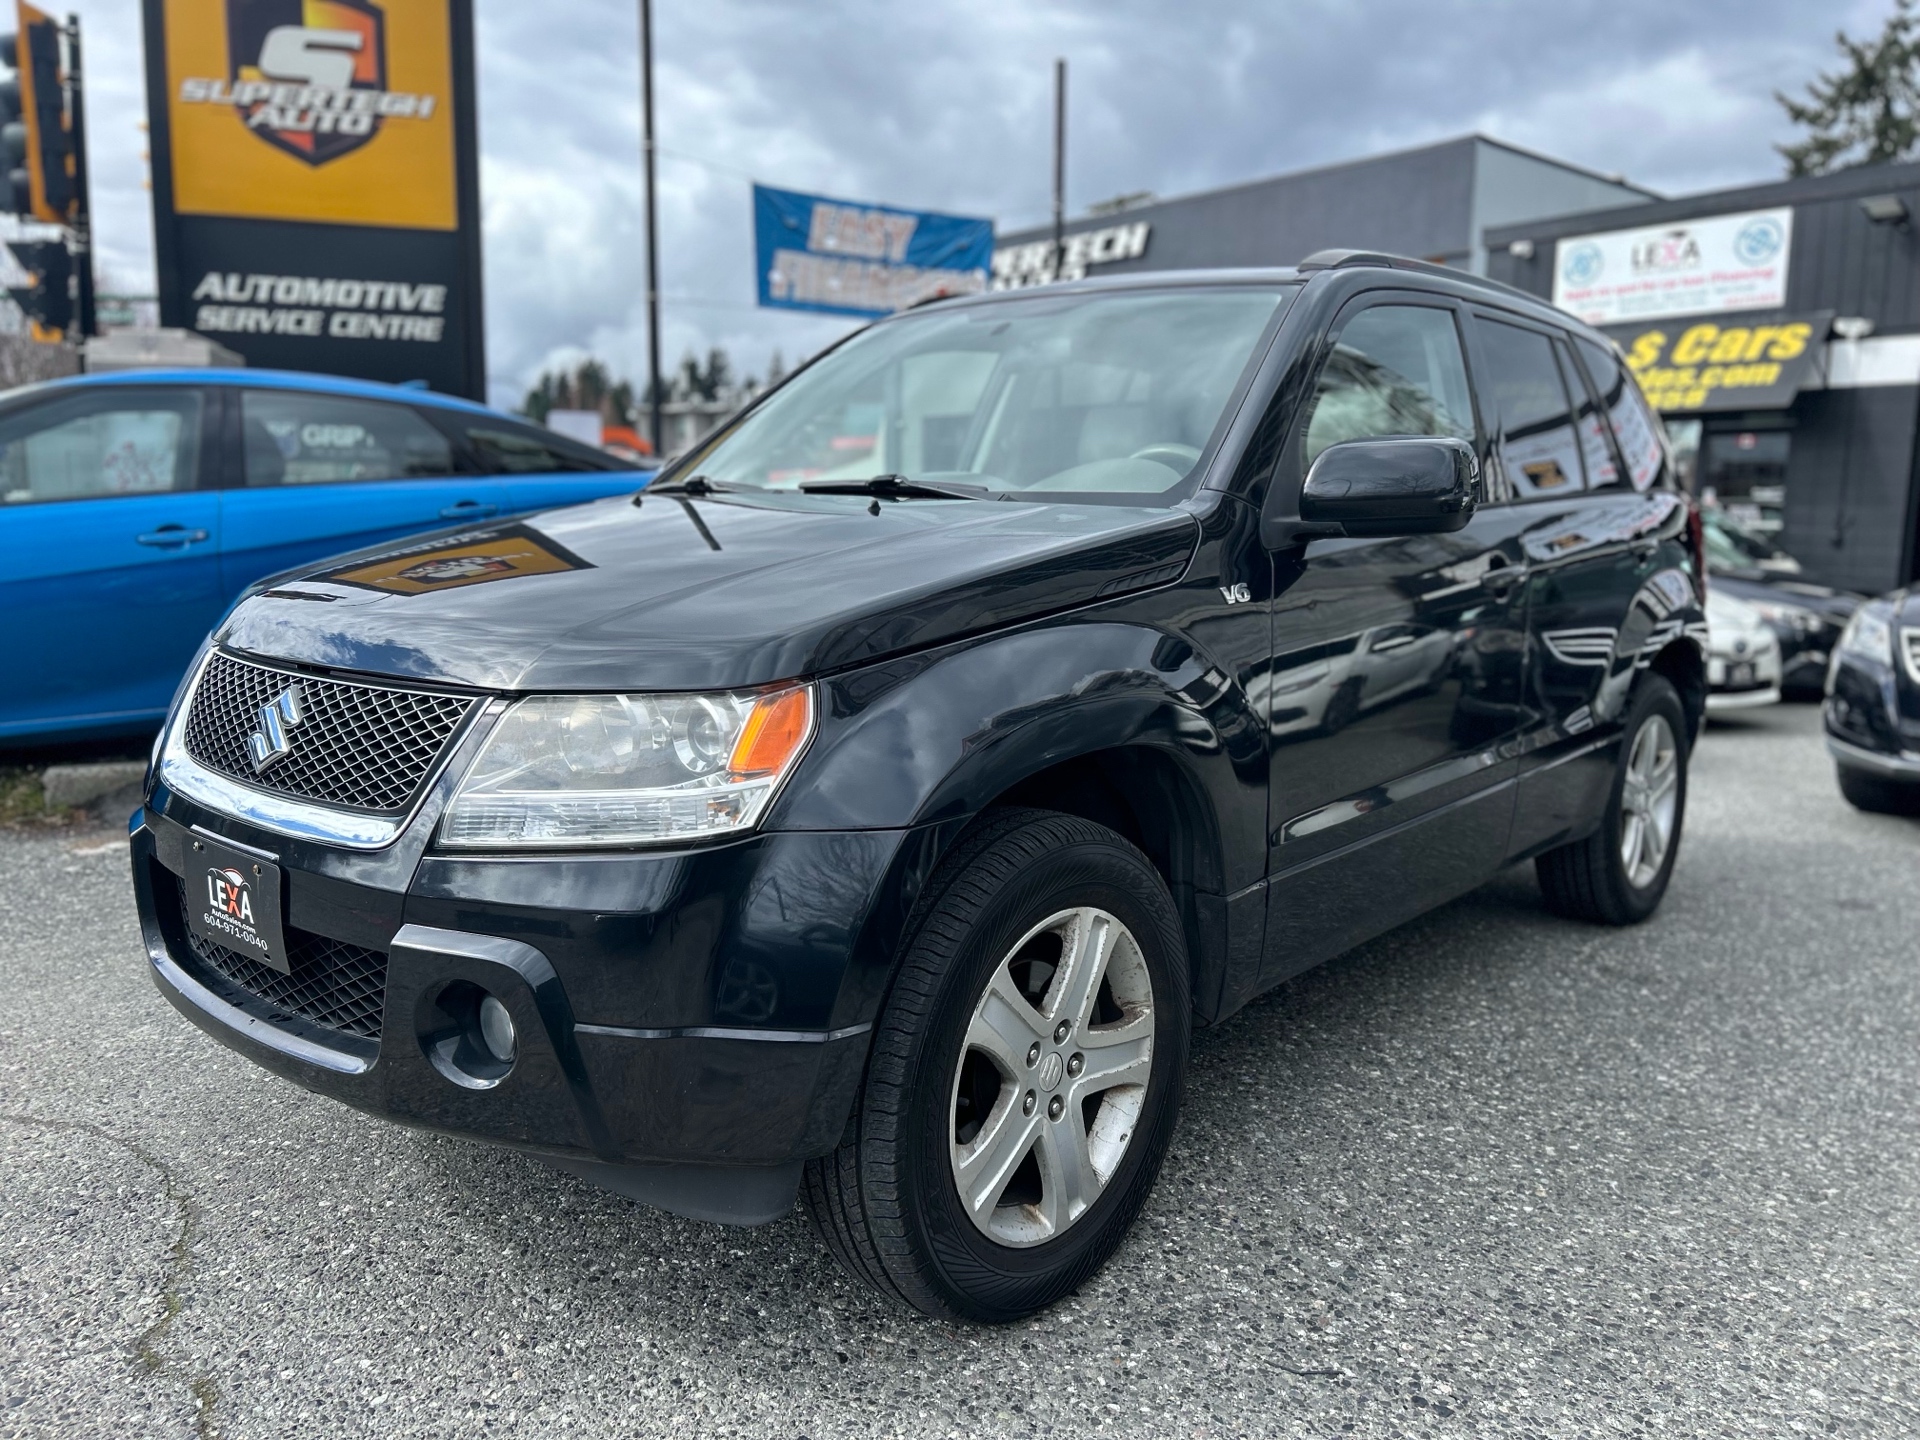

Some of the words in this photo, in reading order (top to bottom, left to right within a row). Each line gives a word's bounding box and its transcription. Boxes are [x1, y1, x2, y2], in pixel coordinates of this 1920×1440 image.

[179, 77, 435, 119] SUPERTECH
[249, 107, 373, 135] AUTO
[807, 202, 919, 262] EASY
[1632, 239, 1701, 268] LEXA
[193, 272, 447, 311] AUTOMOTIVE
[196, 306, 324, 335] SERVICE
[329, 312, 444, 341] CENTRE
[1671, 322, 1813, 365] Cars
[1219, 582, 1251, 605] V6
[207, 874, 255, 924] LEXA
[203, 913, 268, 951] 604-971-0040
[211, 908, 257, 935] AutoSales.com
